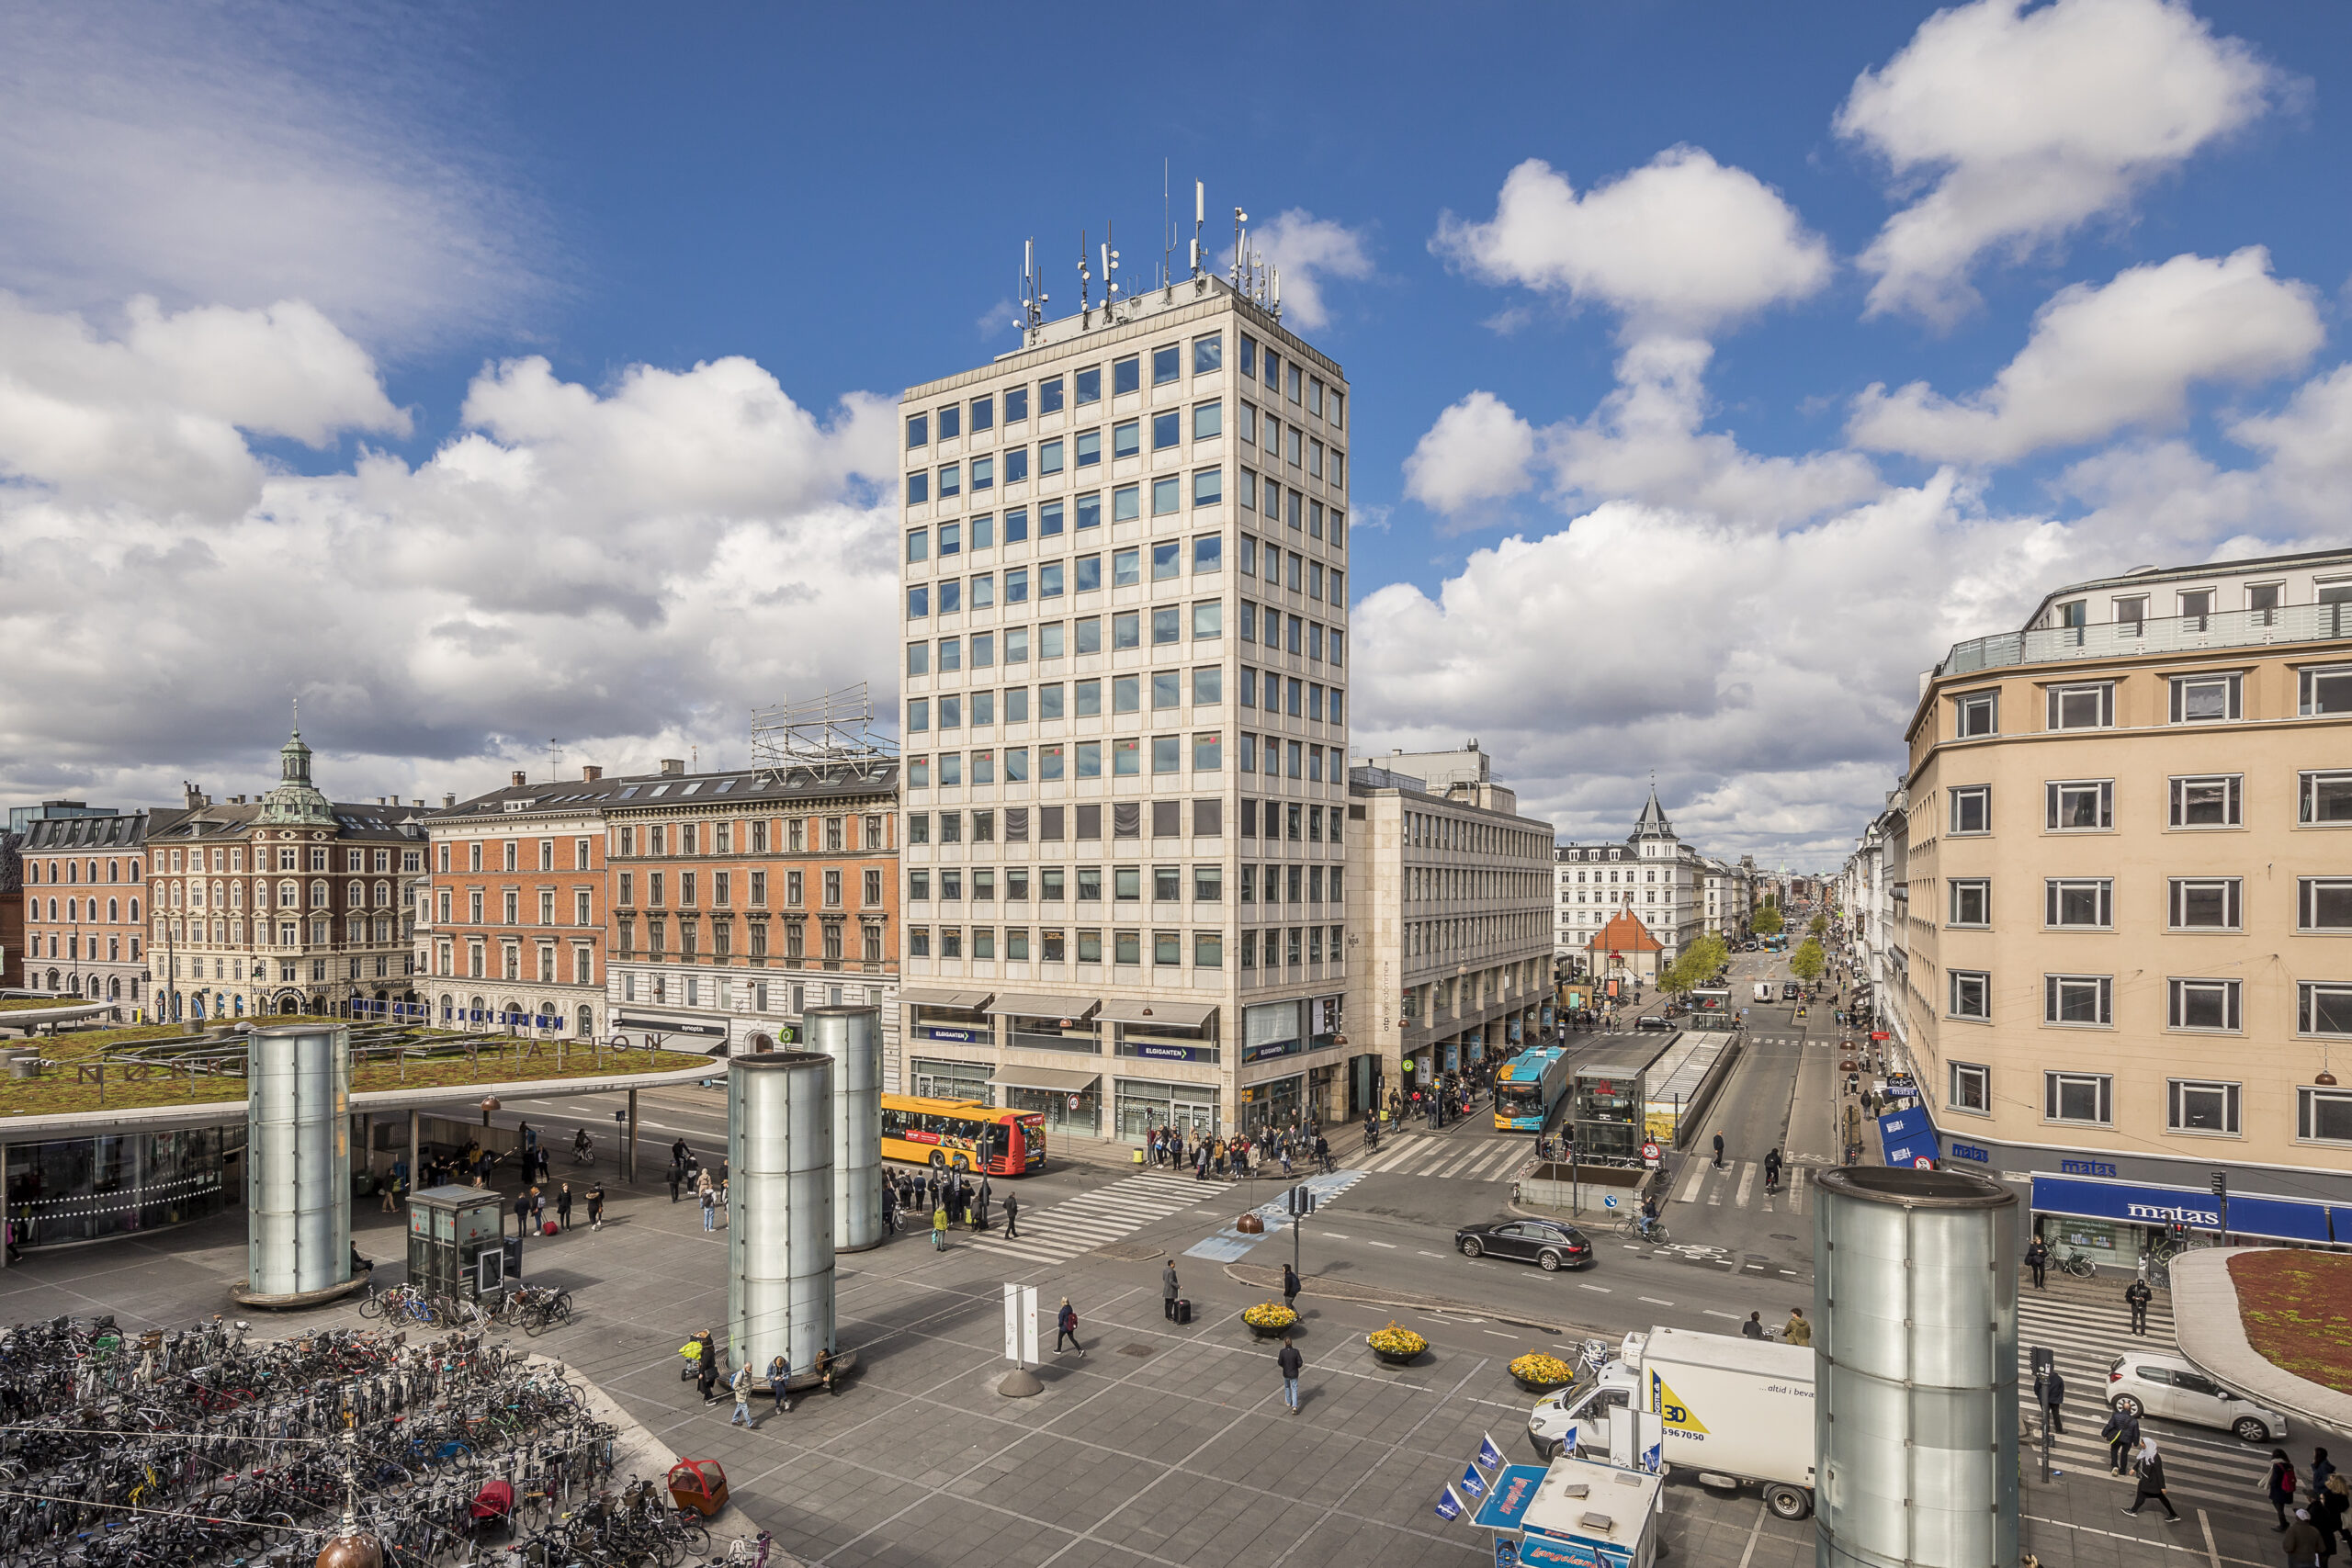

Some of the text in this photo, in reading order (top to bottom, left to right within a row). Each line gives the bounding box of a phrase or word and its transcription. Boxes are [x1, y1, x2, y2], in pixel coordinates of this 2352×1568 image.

[682, 1024, 705, 1032] synoptik
[935, 1031, 965, 1039] ELGIGANTEN
[462, 1032, 662, 1062] STATION
[1261, 1046, 1282, 1055] ELGIGANTEN
[1146, 1047, 1182, 1057] ELGIGANTEN
[1892, 1088, 1915, 1096] matas
[1952, 1143, 1989, 1163] matas
[2061, 1158, 2117, 1178] matas
[2127, 1203, 2219, 1224] matas
[2190, 1239, 2211, 1247] 25%
